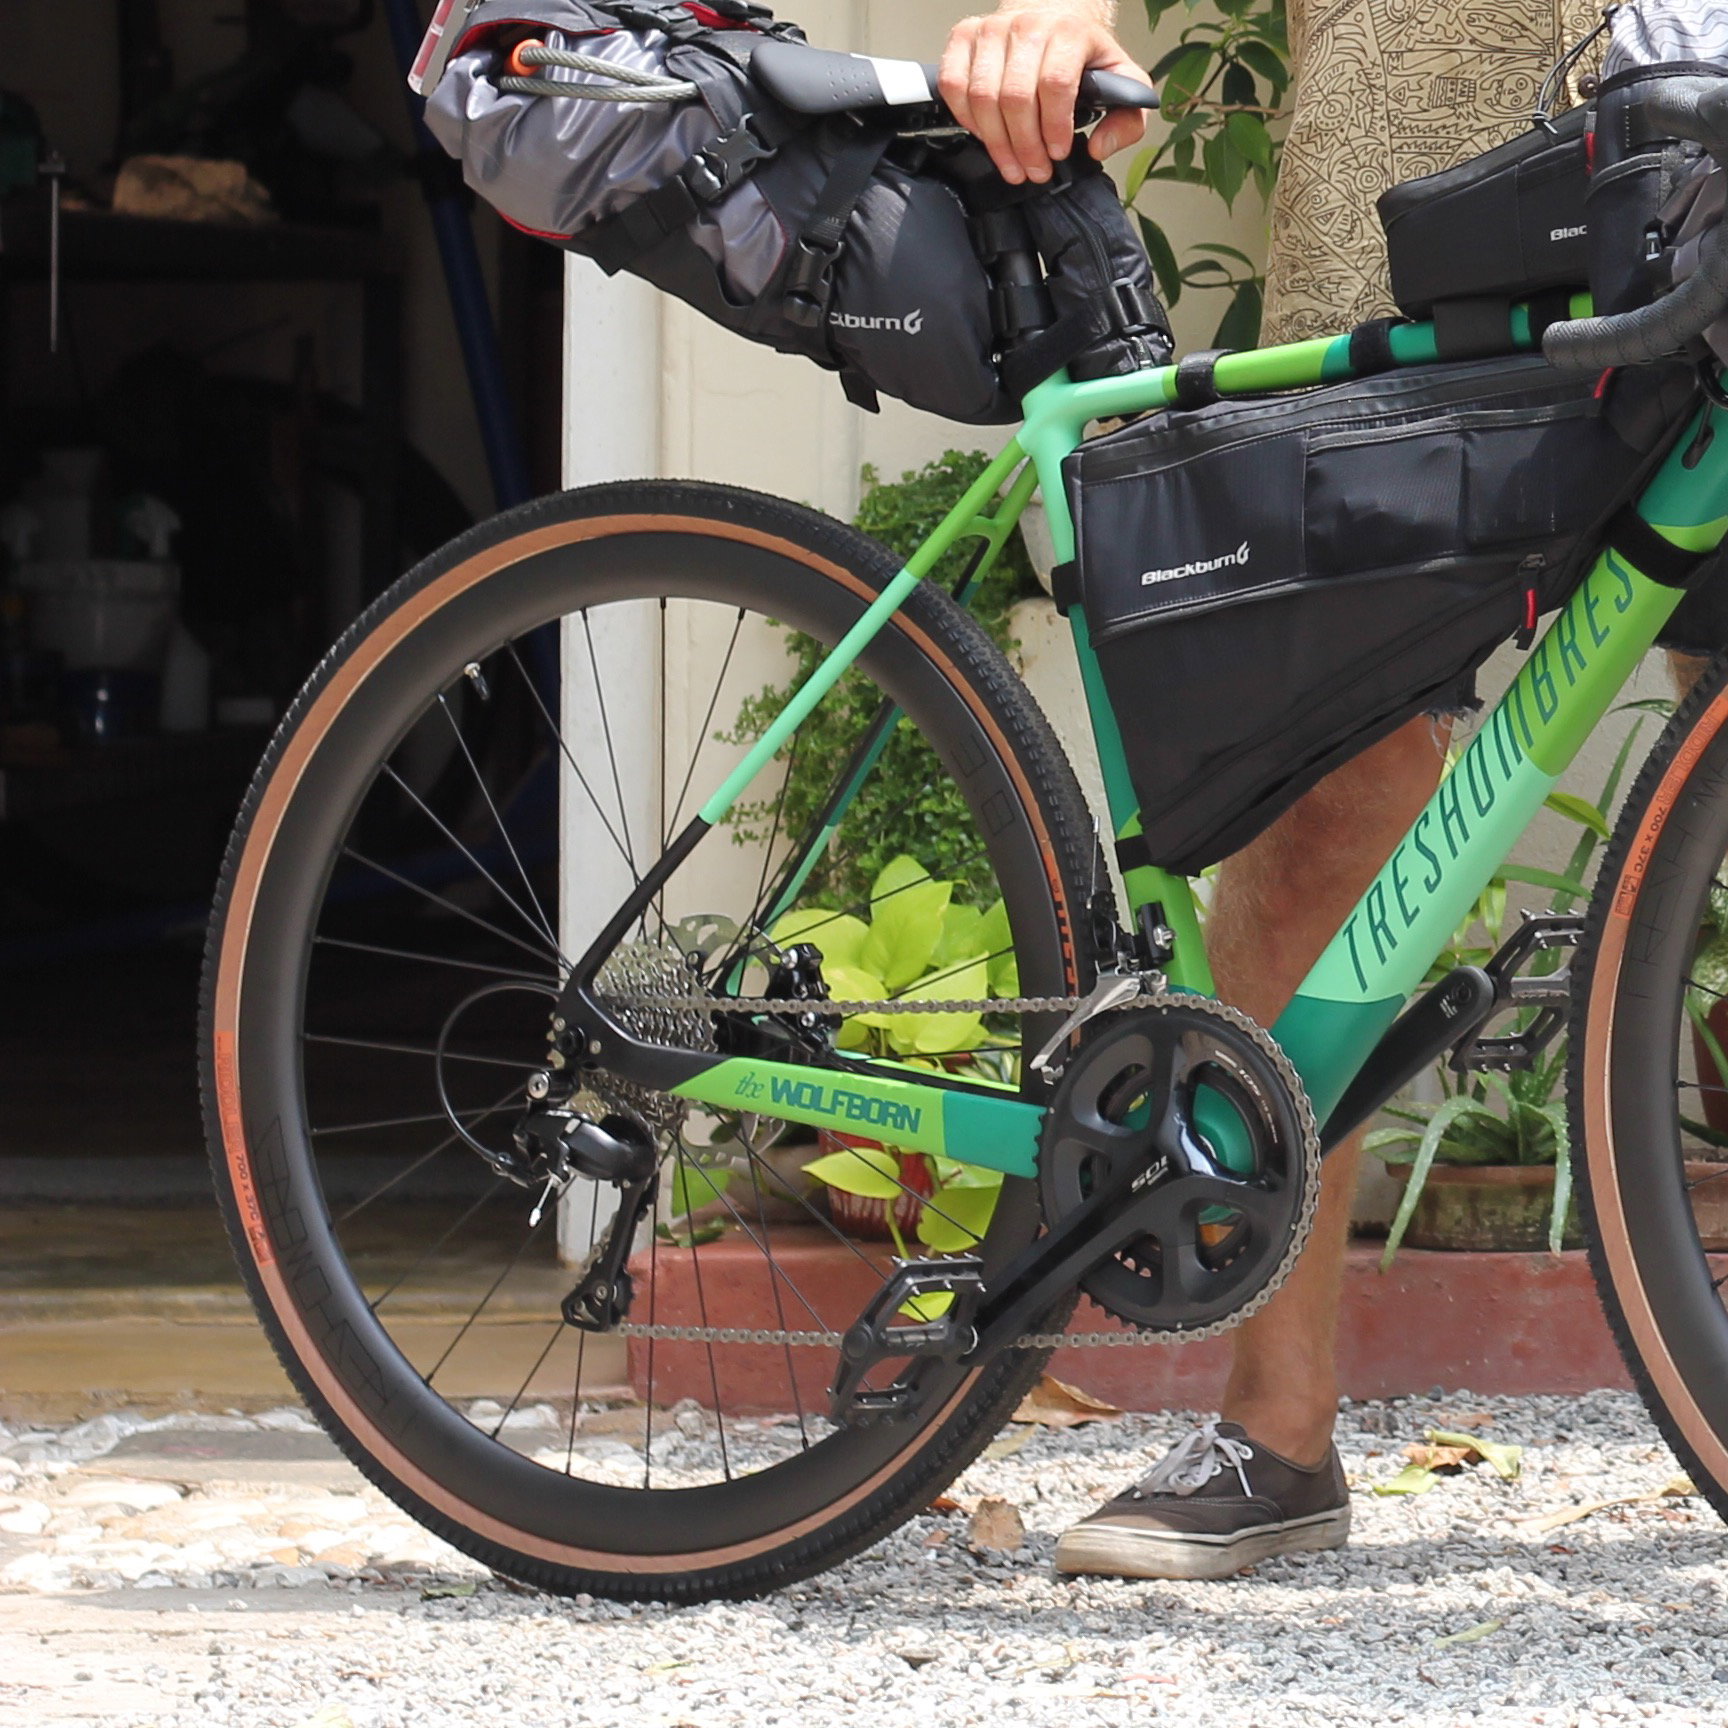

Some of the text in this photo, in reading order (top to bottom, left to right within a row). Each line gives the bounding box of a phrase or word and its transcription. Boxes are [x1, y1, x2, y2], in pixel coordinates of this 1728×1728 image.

[1141, 553, 1236, 586] Blackburn
[1648, 804, 1666, 833] 700
[1632, 842, 1650, 874] 37C
[735, 1072, 922, 1134] the WOLFBORN
[234, 1152, 248, 1181] 700
[243, 1191, 259, 1223] 37C
